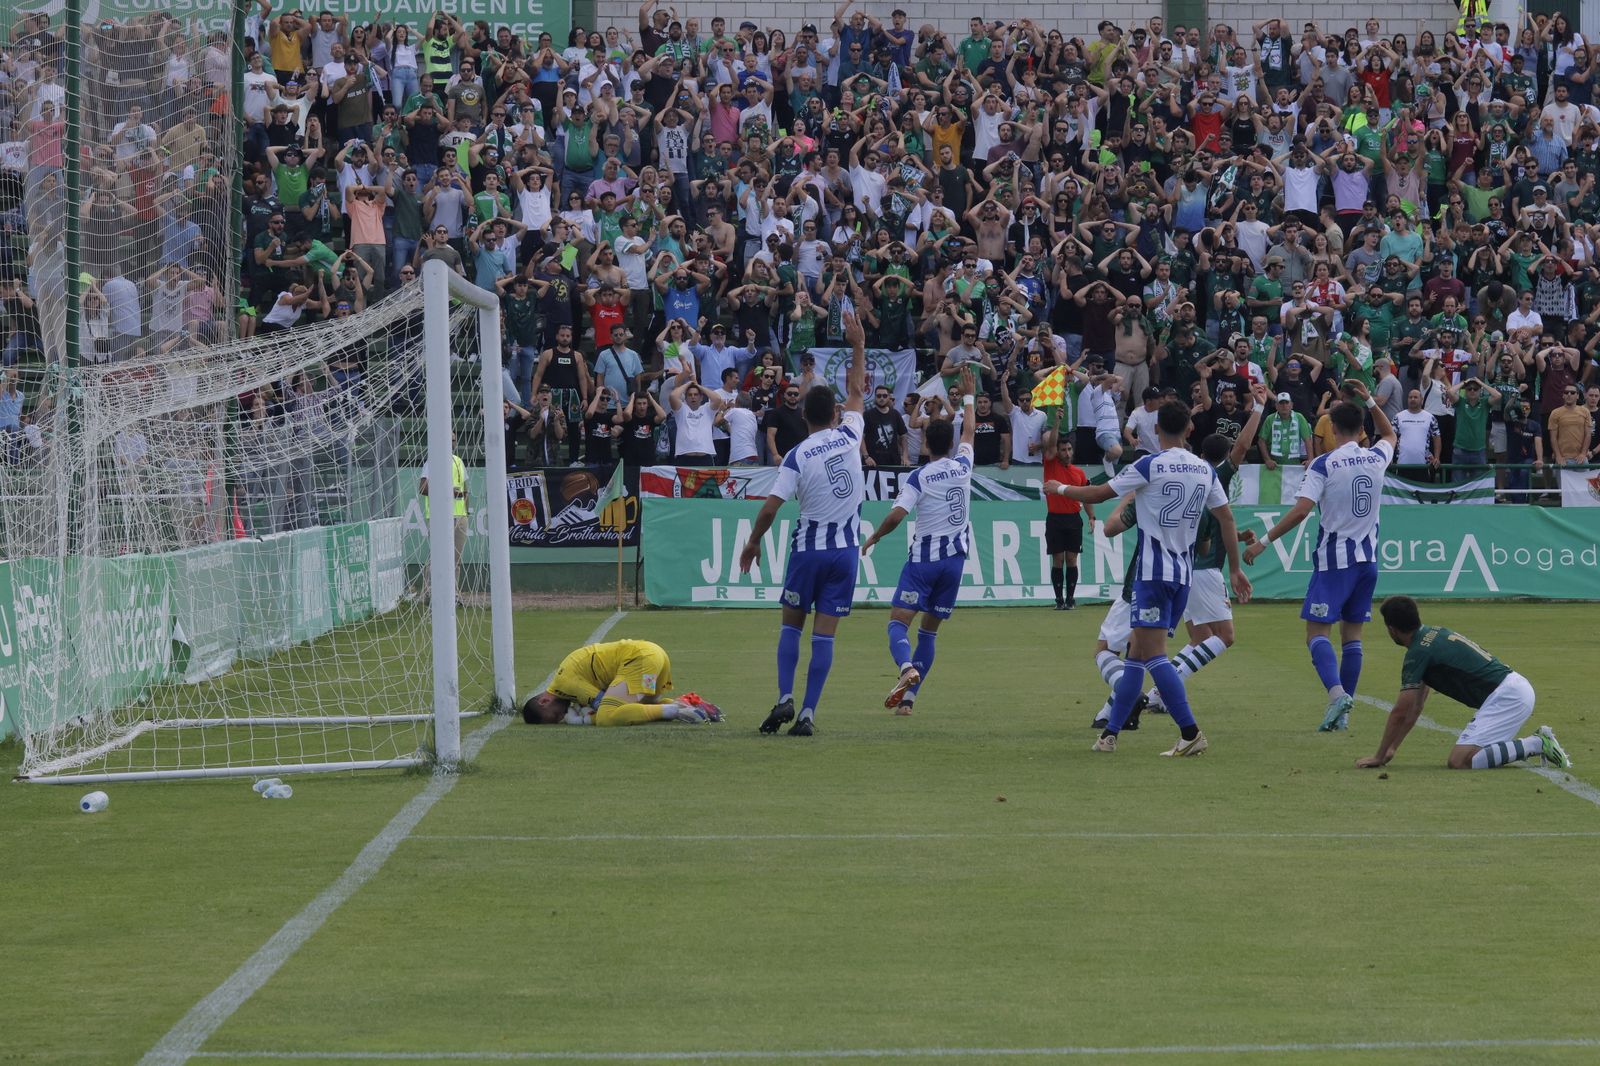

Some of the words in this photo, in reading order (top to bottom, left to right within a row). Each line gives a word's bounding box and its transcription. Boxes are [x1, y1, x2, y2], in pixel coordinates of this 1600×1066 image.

[299, 0, 544, 15] MEDIOAMBIENTE
[803, 437, 850, 460] BERNARDI
[824, 454, 854, 499] 5
[1157, 464, 1168, 474] R.
[1331, 460, 1342, 470] A.
[506, 476, 540, 489] ERIDA
[925, 471, 949, 484] FRAN
[946, 487, 967, 527] 3
[1159, 481, 1206, 529] 24
[1351, 475, 1373, 518] 6
[701, 518, 879, 585] JAVR
